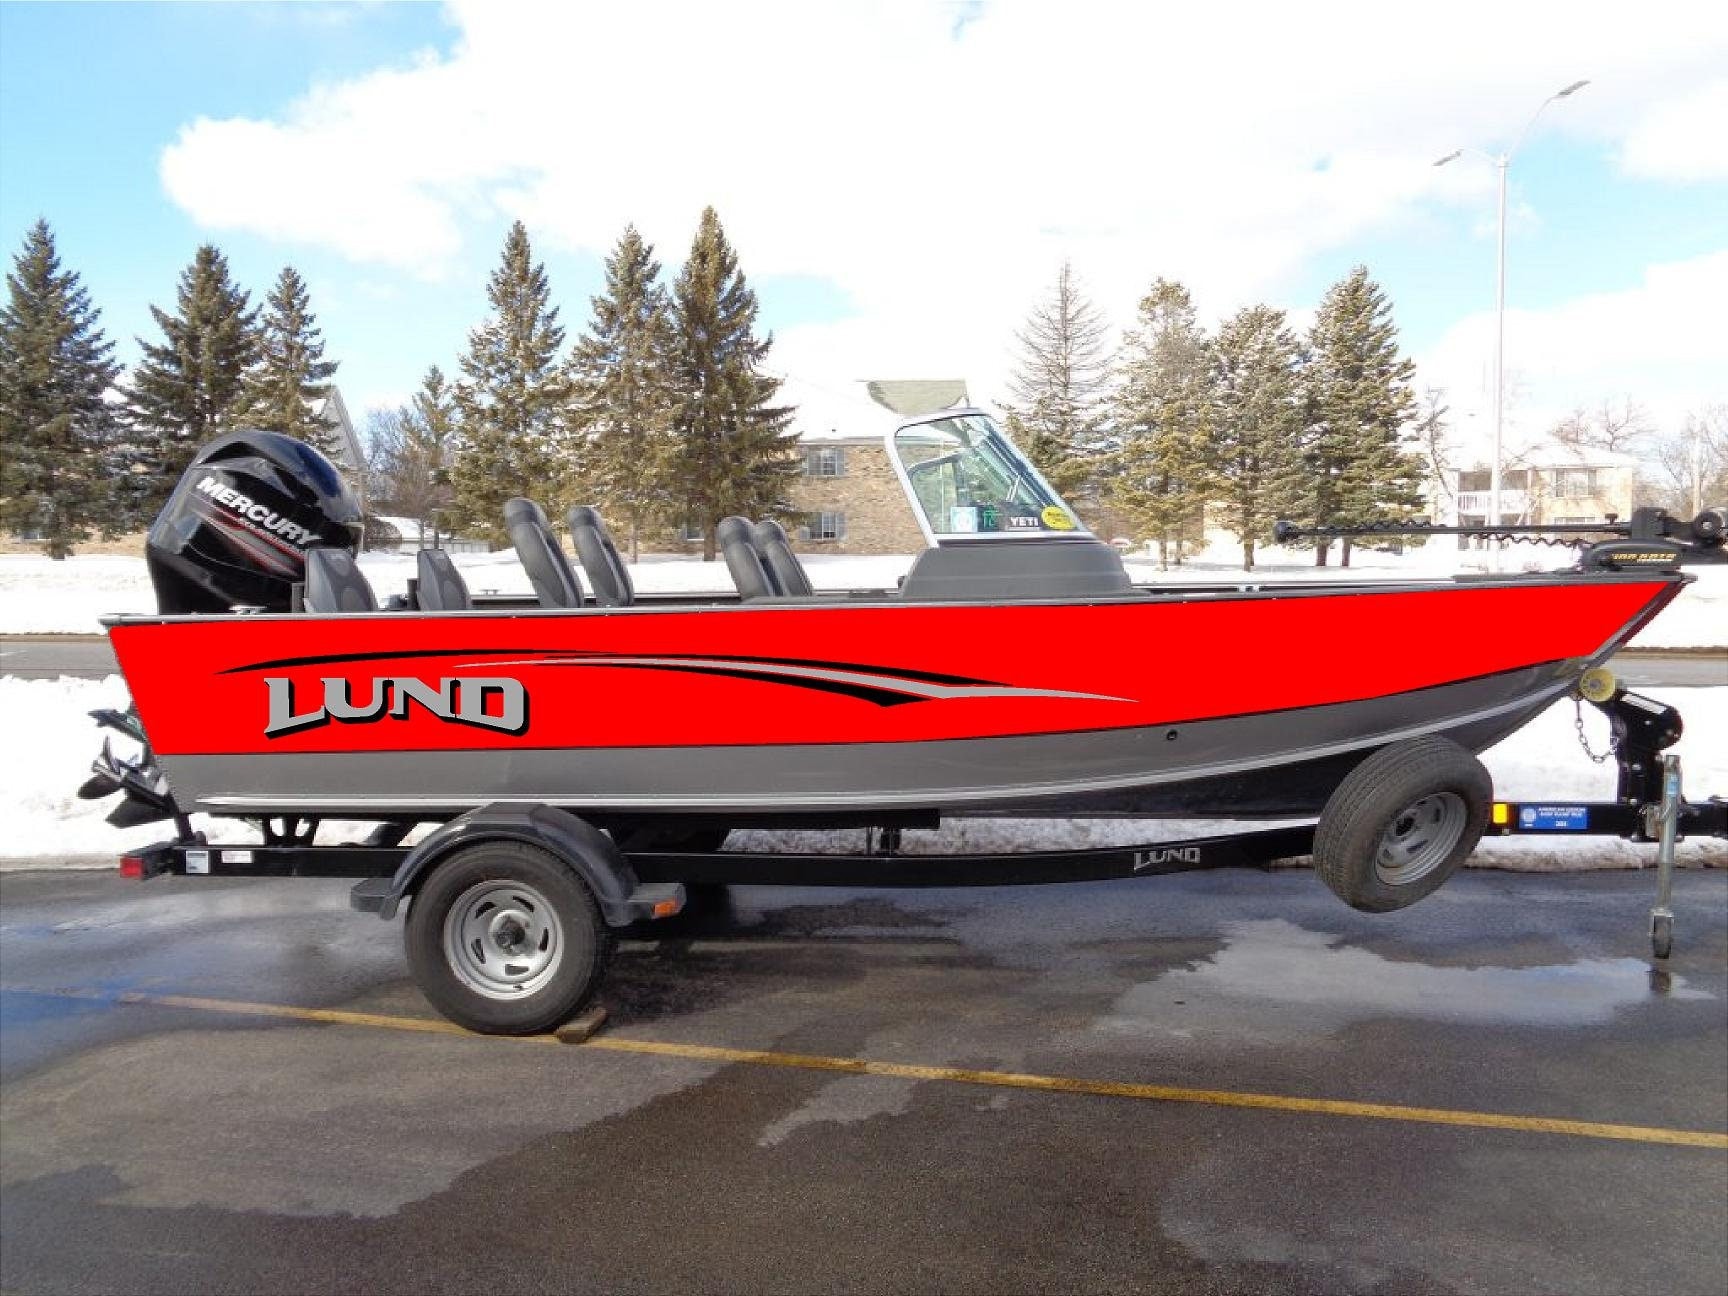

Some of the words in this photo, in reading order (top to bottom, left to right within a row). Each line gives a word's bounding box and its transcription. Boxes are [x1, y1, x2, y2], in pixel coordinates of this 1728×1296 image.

[197, 476, 323, 545] MERCURY
[1010, 516, 1039, 527] YETI
[263, 677, 530, 740] LUND
[1133, 847, 1201, 871] LUND
